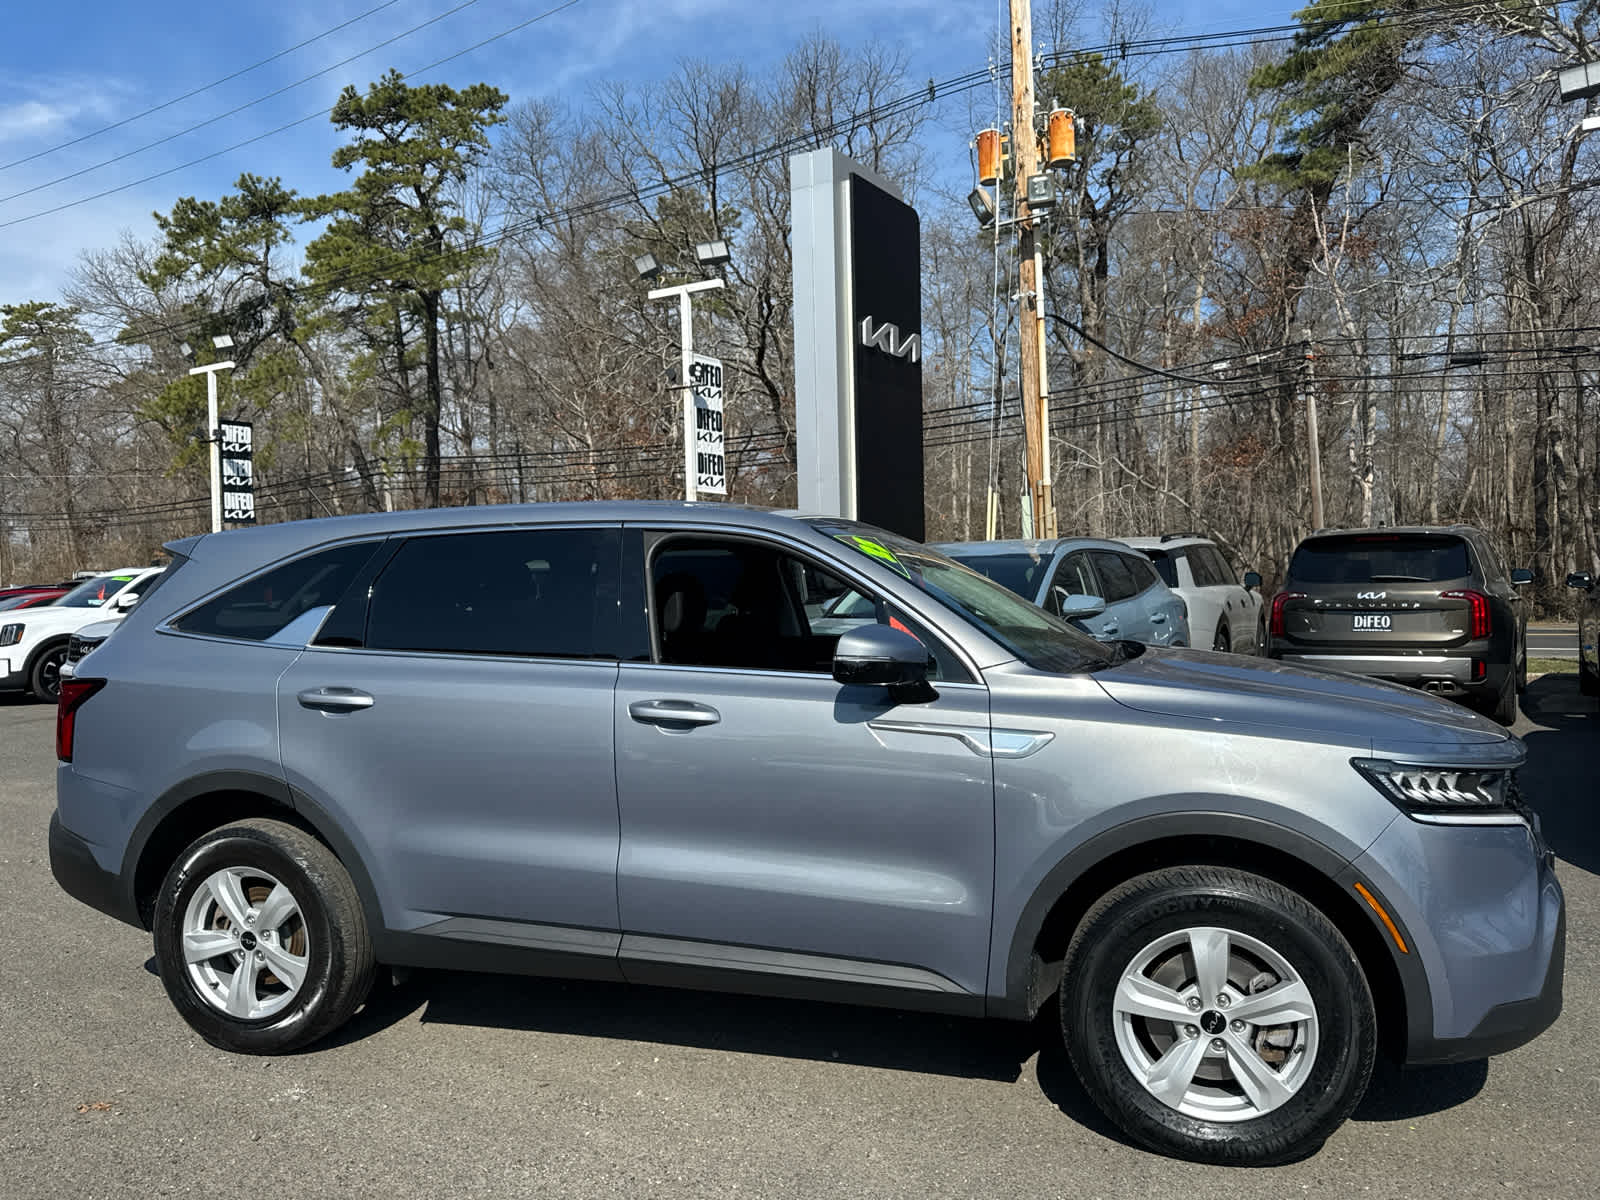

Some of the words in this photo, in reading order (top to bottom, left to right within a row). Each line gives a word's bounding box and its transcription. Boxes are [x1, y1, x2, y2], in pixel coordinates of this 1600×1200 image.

[861, 315, 921, 363] KIA
[696, 386, 722, 399] KIA
[697, 432, 723, 443] KIA
[222, 442, 252, 453] KIA
[698, 452, 724, 476] DiFEO
[223, 476, 253, 486] KIA
[698, 476, 725, 488] KIA
[224, 510, 255, 519] KIA
[1357, 591, 1387, 600] KIA
[1354, 615, 1391, 628] DiFEO
